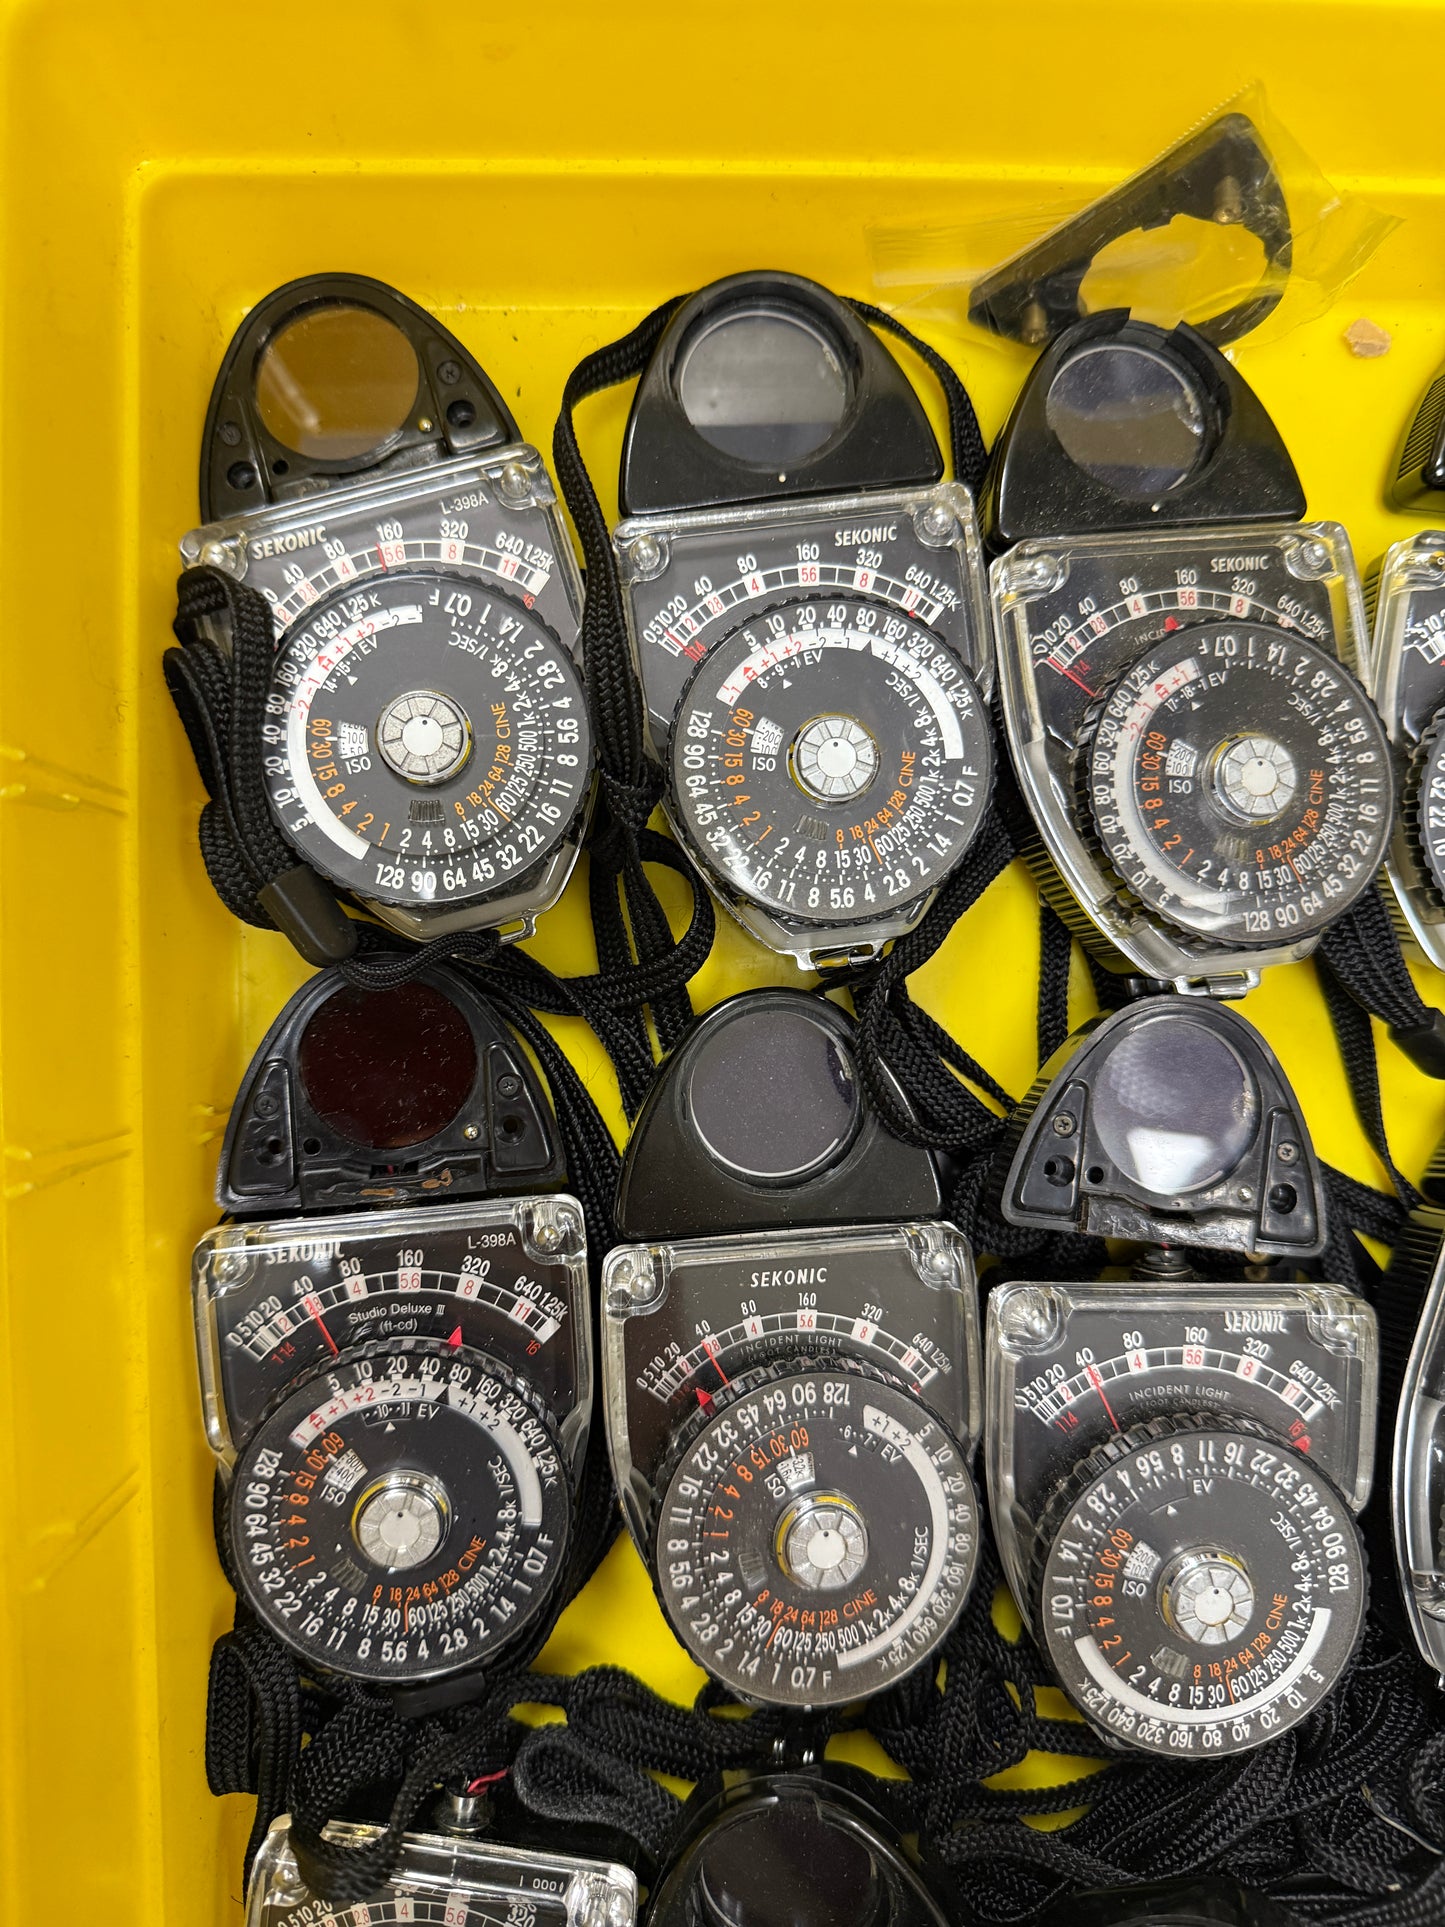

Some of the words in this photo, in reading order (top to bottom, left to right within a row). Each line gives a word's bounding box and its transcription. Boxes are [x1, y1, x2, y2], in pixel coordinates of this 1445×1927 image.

[440, 490, 489, 515] L-398A
[252, 526, 328, 560] SEKONIC
[834, 526, 897, 547] SEKONIC
[282, 563, 306, 580] 40
[324, 539, 346, 559] 80
[377, 522, 404, 541] 160
[440, 520, 469, 539] 320
[496, 532, 524, 556] 640
[1210, 556, 1269, 573] SEKONIC
[668, 595, 688, 615] 20
[694, 576, 713, 597] 40
[736, 554, 758, 573] 80
[796, 544, 820, 562] 160
[856, 550, 882, 569] 320
[904, 566, 931, 589] 640
[444, 592, 472, 617] 0.7
[1052, 615, 1072, 634] 20
[1078, 597, 1096, 616] 40
[1119, 578, 1139, 595] 80
[1175, 569, 1197, 585] 160
[1231, 577, 1255, 596] 320
[1277, 596, 1301, 617] 640
[499, 616, 524, 643] 1.4
[358, 634, 378, 655] EV
[523, 640, 544, 659] 2
[804, 649, 823, 666] EV
[537, 660, 565, 689] 2.8
[1209, 671, 1227, 687] EV
[1310, 670, 1339, 698] 2.8
[552, 697, 573, 709] 4
[491, 702, 511, 739] CINE
[557, 718, 579, 743] 5.6
[686, 709, 713, 739] 128
[347, 757, 372, 774] ISO
[557, 754, 579, 767] 8
[684, 743, 705, 769] 90
[752, 756, 776, 772] ISO
[898, 751, 916, 787] CINE
[549, 779, 574, 798] 11
[686, 774, 708, 798] 64
[951, 780, 975, 806] 0.7
[1168, 780, 1192, 794] ISO
[1309, 769, 1324, 804] CINE
[1360, 778, 1379, 793] 11
[536, 803, 561, 825] 16
[693, 802, 717, 826] 45
[1358, 804, 1379, 823] 16
[518, 826, 545, 852] 22
[706, 826, 729, 852] 32
[926, 833, 952, 858] 1.4
[1350, 830, 1373, 855] 22
[496, 845, 522, 870] 32
[1337, 854, 1362, 879] 32
[375, 864, 404, 889] 128
[411, 871, 437, 892] 90
[442, 868, 467, 890] 64
[472, 858, 495, 883] 45
[749, 866, 772, 891] 16
[882, 869, 911, 896] 2.8
[778, 878, 795, 901] 11
[830, 887, 855, 909] 5.6
[1320, 875, 1343, 899] 45
[1300, 891, 1322, 916] 64
[1243, 912, 1271, 933] 128
[1275, 905, 1300, 928] 90
[467, 1233, 517, 1250] L-398A
[259, 1295, 282, 1315] 20
[292, 1276, 314, 1295] 40
[339, 1258, 362, 1276] 80
[399, 1250, 424, 1267] 160
[461, 1255, 491, 1276] 320
[512, 1275, 543, 1300] 640
[750, 1267, 828, 1287] SEKONIC
[349, 1305, 388, 1324] Studio
[391, 1304, 433, 1315] Deluxe
[379, 1318, 418, 1332] (ft-cd)
[664, 1342, 681, 1355] 20
[695, 1320, 711, 1336] 40
[740, 1300, 757, 1314] 80
[798, 1292, 816, 1306] 160
[861, 1302, 883, 1321] 320
[912, 1332, 933, 1353] 640
[740, 1335, 800, 1355] INCIDENT
[808, 1335, 843, 1348] LIGHT
[1045, 1363, 1066, 1382] 20
[1075, 1347, 1094, 1366] 40
[1122, 1331, 1143, 1348] 80
[1184, 1326, 1208, 1343] 160
[1242, 1338, 1271, 1358] 320
[1289, 1360, 1313, 1382] 640
[763, 1393, 786, 1415] 64
[791, 1382, 816, 1404] 90
[822, 1382, 851, 1405] 128
[1128, 1384, 1189, 1400] INCIDENT
[1194, 1386, 1231, 1399] LIGHT
[417, 1406, 440, 1420] EV
[736, 1405, 760, 1429] 45
[711, 1425, 739, 1448] 32
[252, 1448, 283, 1479] 128
[691, 1443, 718, 1471] 22
[880, 1445, 901, 1463] EV
[1135, 1450, 1164, 1472] 5.6
[1198, 1441, 1214, 1462] 11
[1223, 1442, 1245, 1465] 16
[1249, 1449, 1276, 1475] 22
[678, 1475, 703, 1498] 16
[763, 1473, 786, 1499] ISO
[1193, 1480, 1214, 1494] EV
[1273, 1462, 1301, 1490] 32
[245, 1482, 270, 1509] 90
[319, 1486, 347, 1507] ISO
[244, 1514, 268, 1538] 64
[669, 1506, 693, 1524] 11
[1310, 1505, 1336, 1531] 64
[250, 1541, 274, 1566] 45
[458, 1534, 487, 1570] CINE
[1057, 1538, 1083, 1561] 1.4
[1322, 1532, 1347, 1558] 90
[259, 1567, 285, 1594] 32
[669, 1560, 694, 1589] 5.6
[1327, 1563, 1350, 1594] 128
[274, 1590, 302, 1618] 22
[491, 1596, 517, 1621] 1.4
[842, 1589, 878, 1617] CINE
[1050, 1594, 1074, 1621] 0.7
[1265, 1592, 1289, 1630] CINE
[299, 1611, 324, 1637] 16
[472, 1617, 490, 1639] 2
[690, 1613, 719, 1641] 2.8
[325, 1626, 347, 1650] 11
[357, 1638, 371, 1659] 8
[418, 1640, 430, 1659] 4
[439, 1628, 469, 1655] 2.8
[737, 1651, 761, 1677] 1.4
[790, 1667, 816, 1688] 0.7
[400, 1902, 410, 1918] 4
